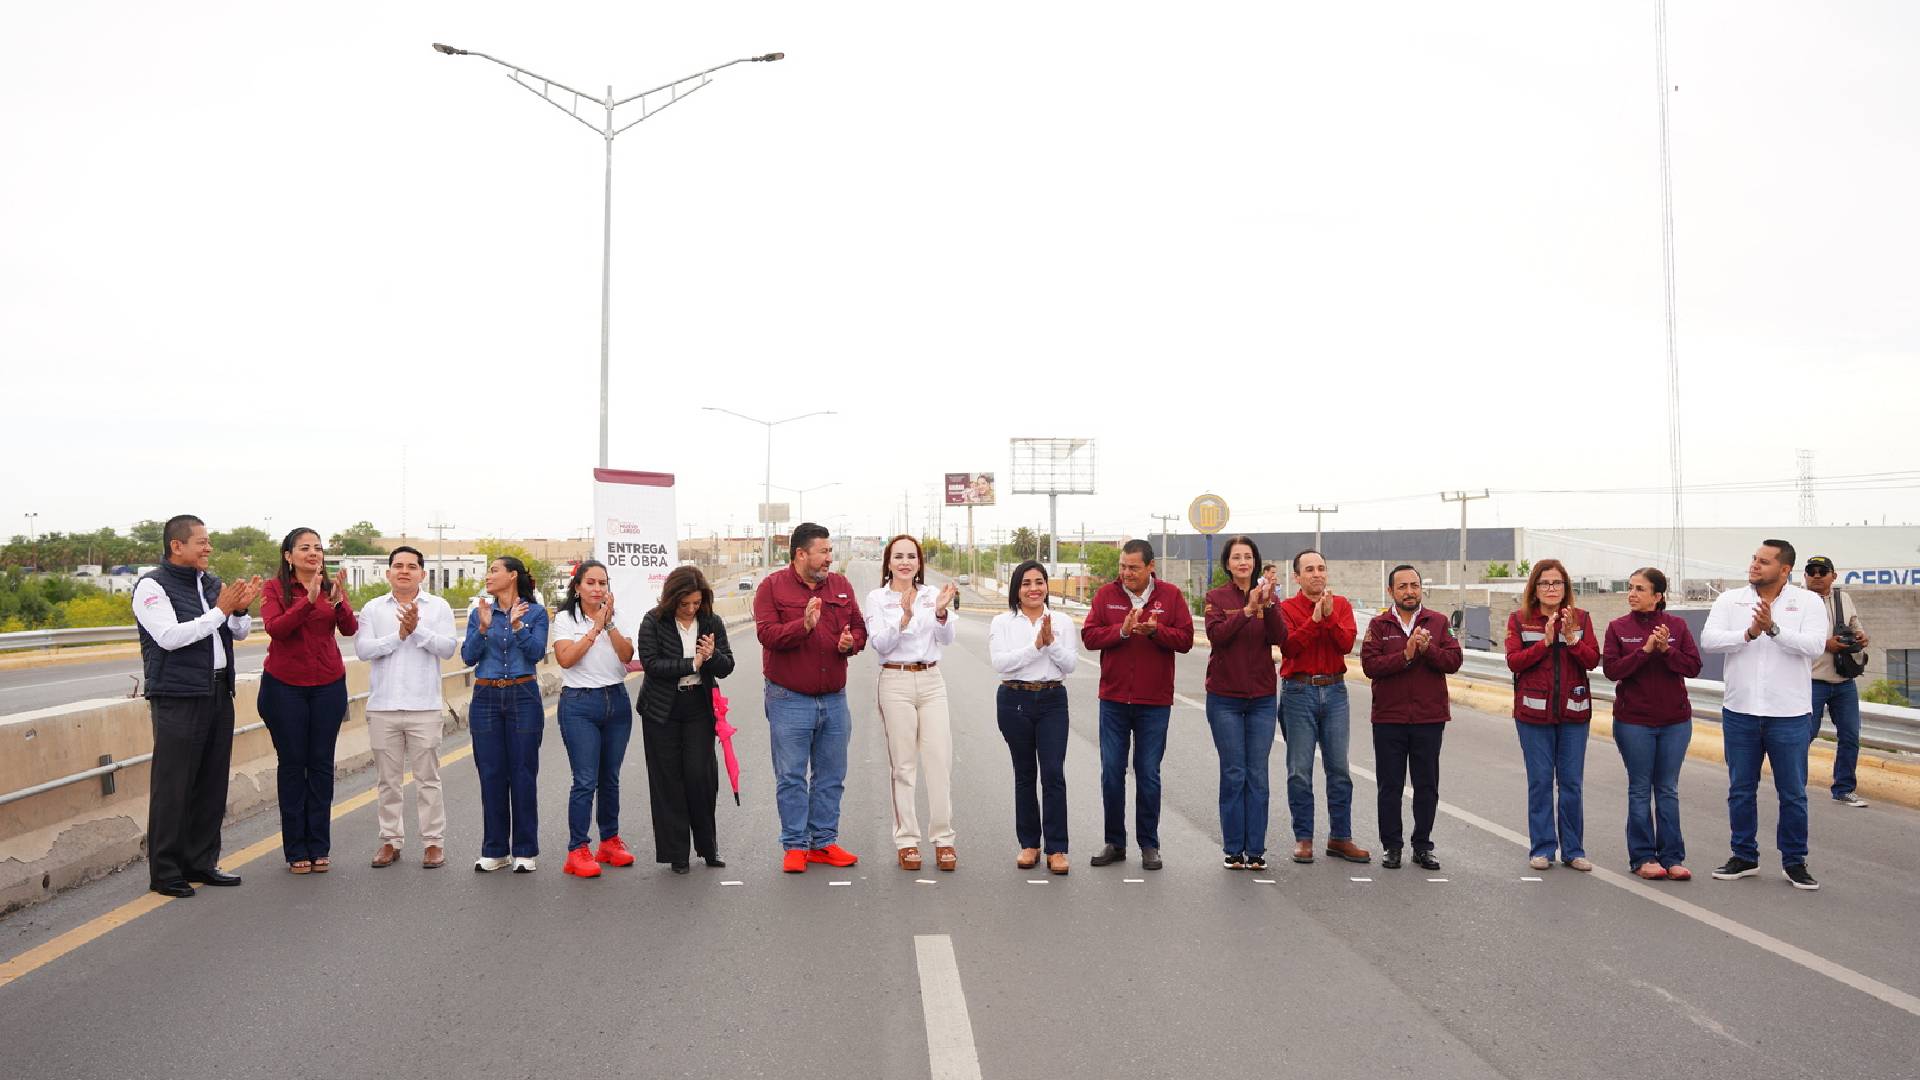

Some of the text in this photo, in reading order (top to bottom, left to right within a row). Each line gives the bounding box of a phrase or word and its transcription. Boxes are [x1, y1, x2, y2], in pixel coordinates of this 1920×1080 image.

[608, 542, 667, 554] ENTREGA
[608, 554, 668, 567] DE OBRA
